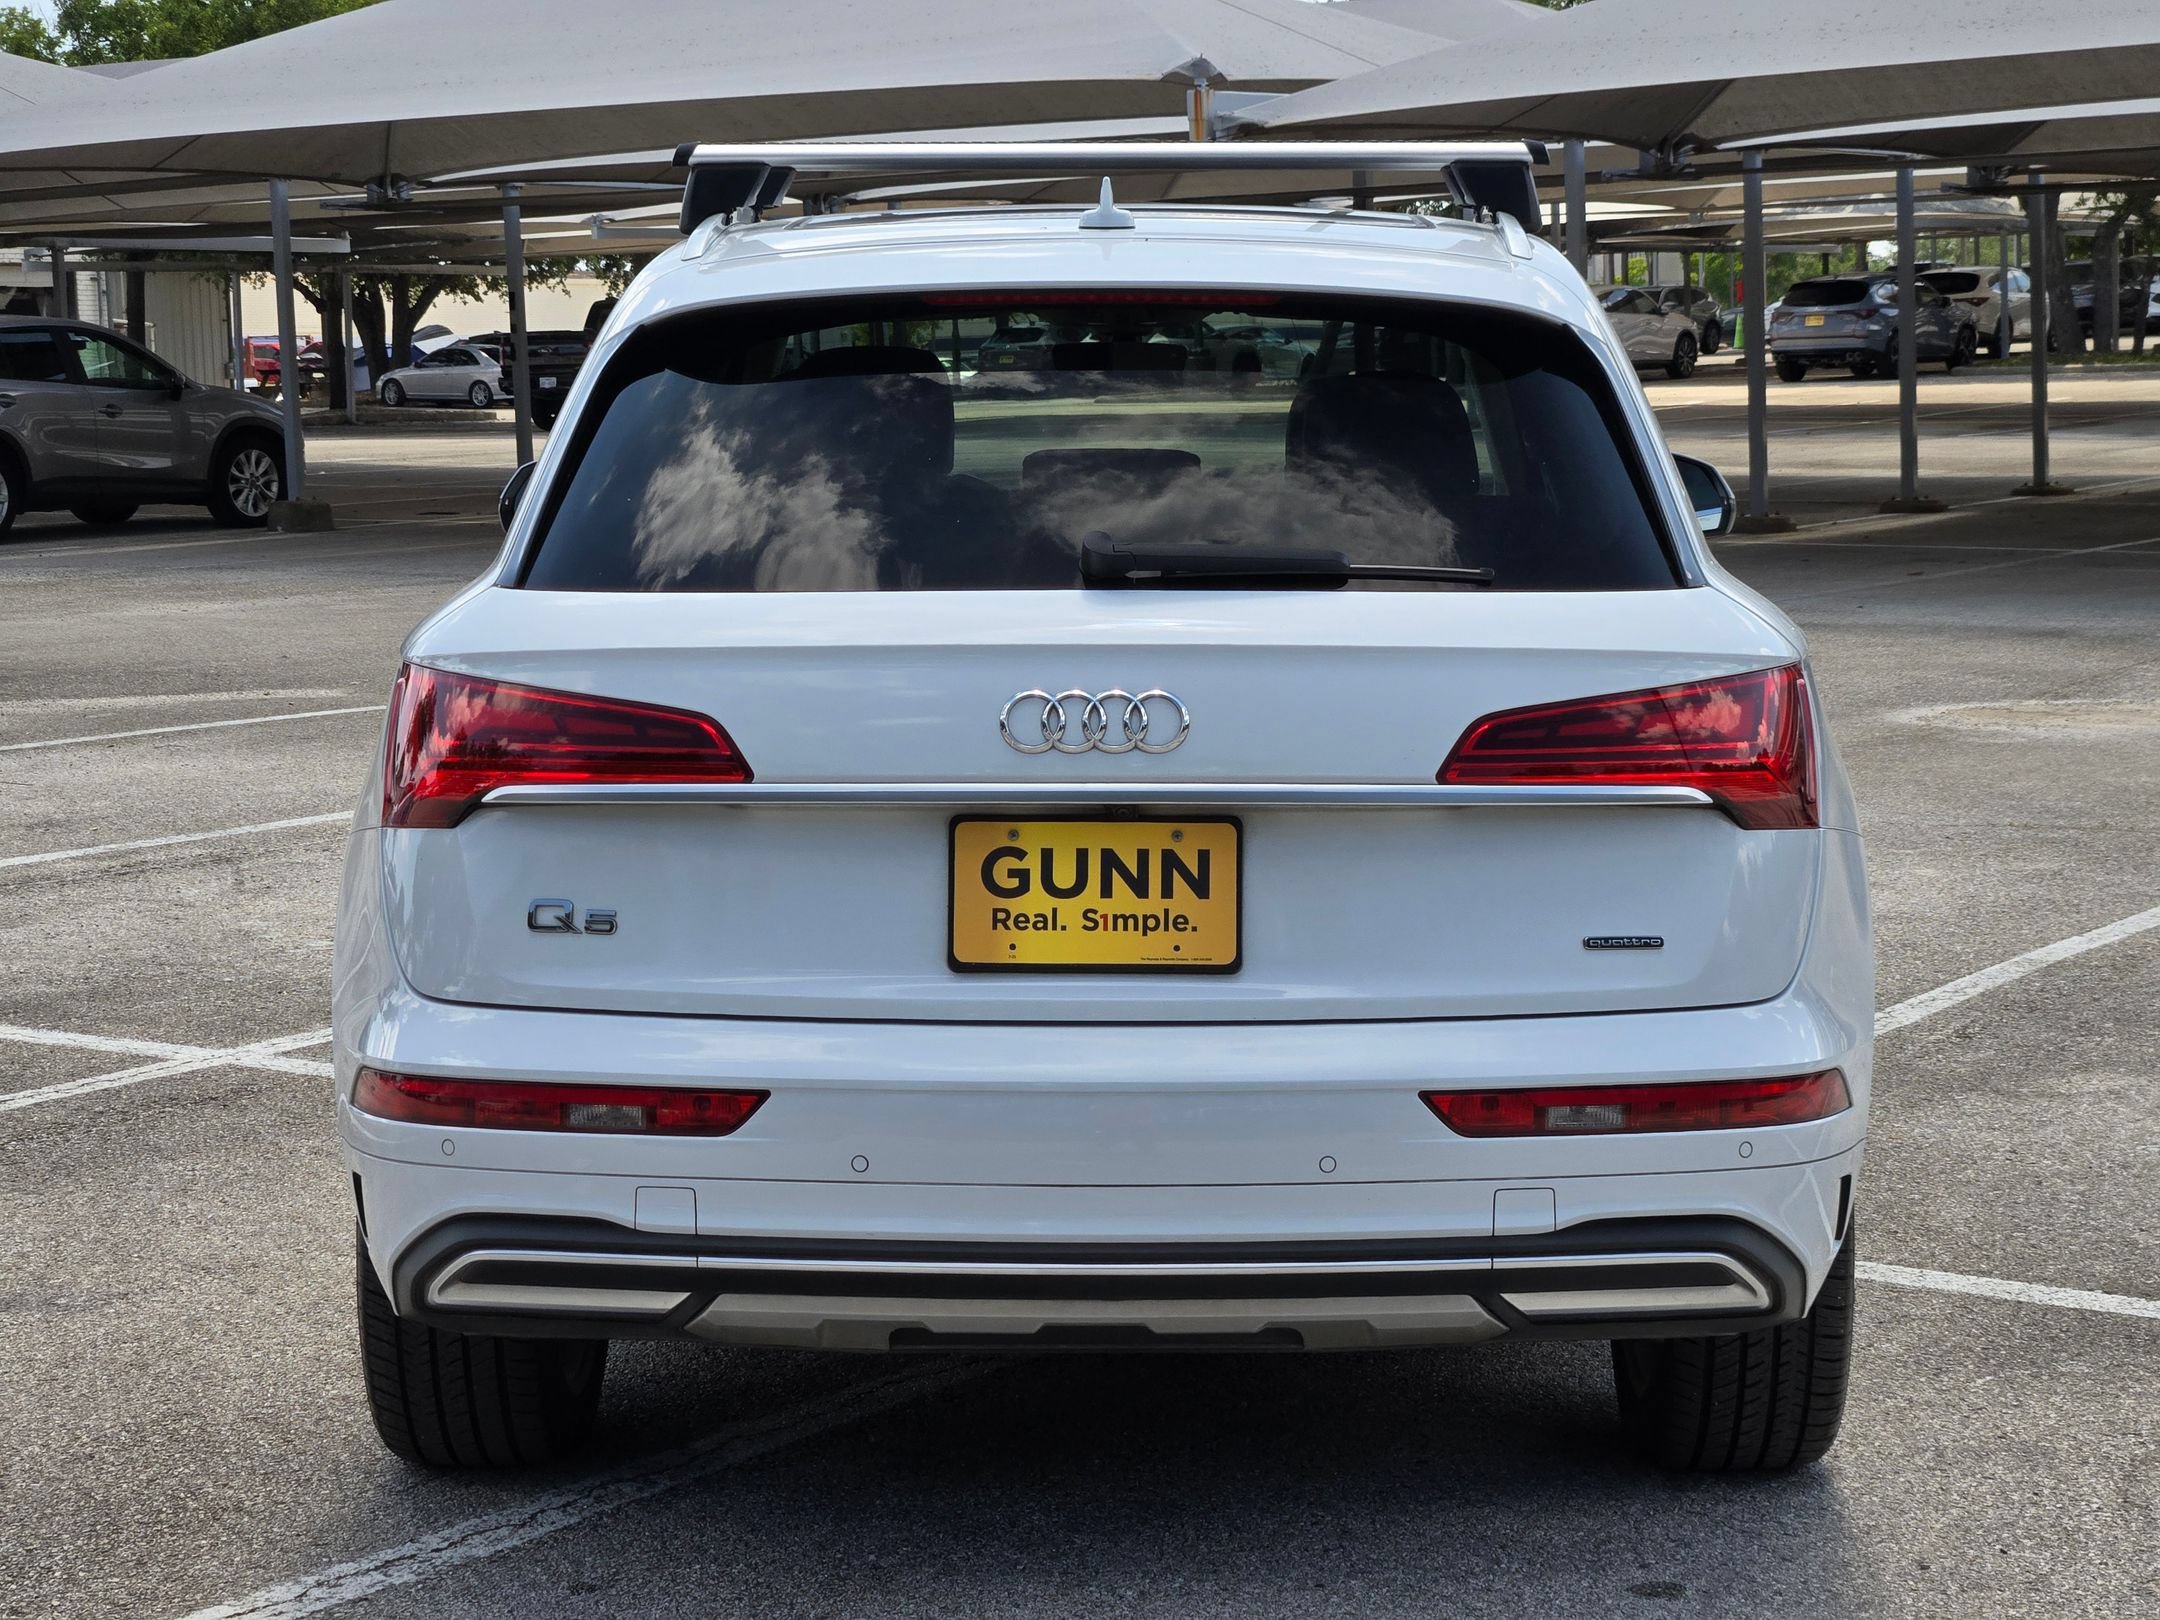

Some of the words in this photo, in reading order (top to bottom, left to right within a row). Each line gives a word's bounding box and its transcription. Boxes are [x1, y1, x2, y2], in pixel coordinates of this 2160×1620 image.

[980, 845, 1211, 900] GUNN
[527, 897, 618, 936] Q5
[991, 906, 1067, 932] Real.
[1588, 938, 1662, 948] quattro
